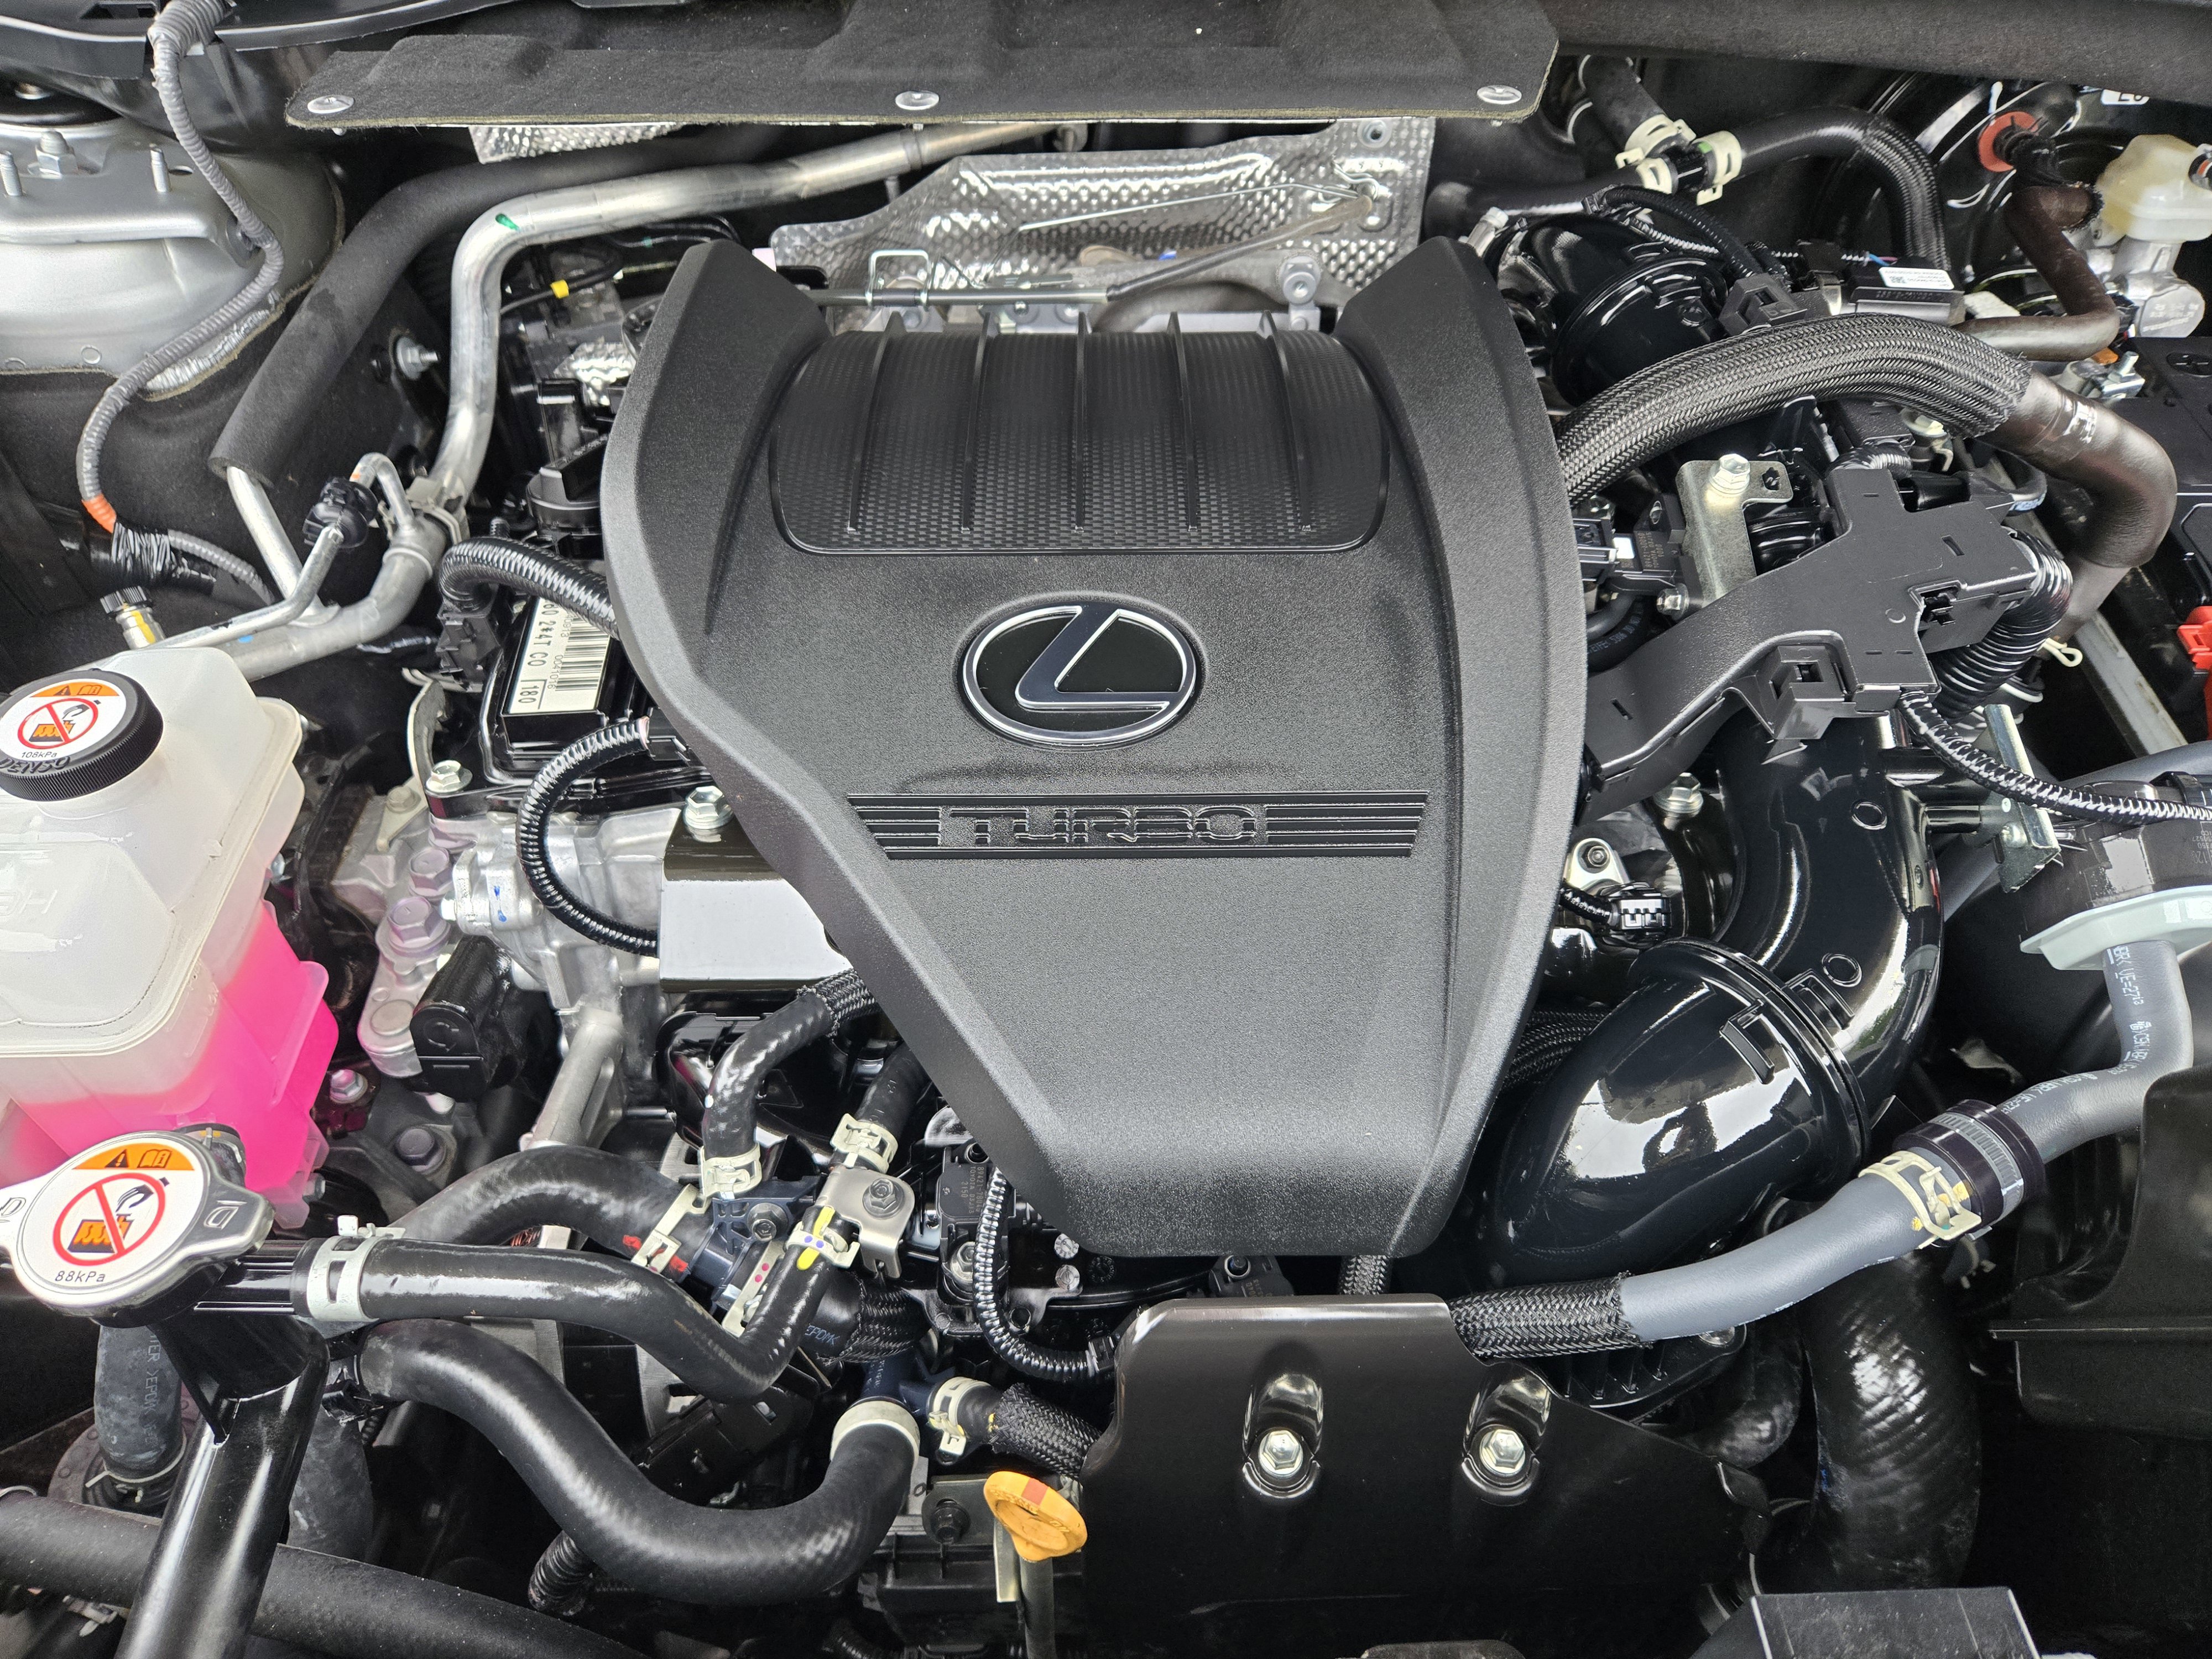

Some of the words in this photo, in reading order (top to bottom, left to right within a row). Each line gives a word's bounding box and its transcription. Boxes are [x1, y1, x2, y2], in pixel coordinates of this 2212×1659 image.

[518, 685, 540, 703] 180
[0, 756, 70, 774] DENSO
[950, 806, 1256, 844] TURBO
[54, 1270, 106, 1282] 88kPa
